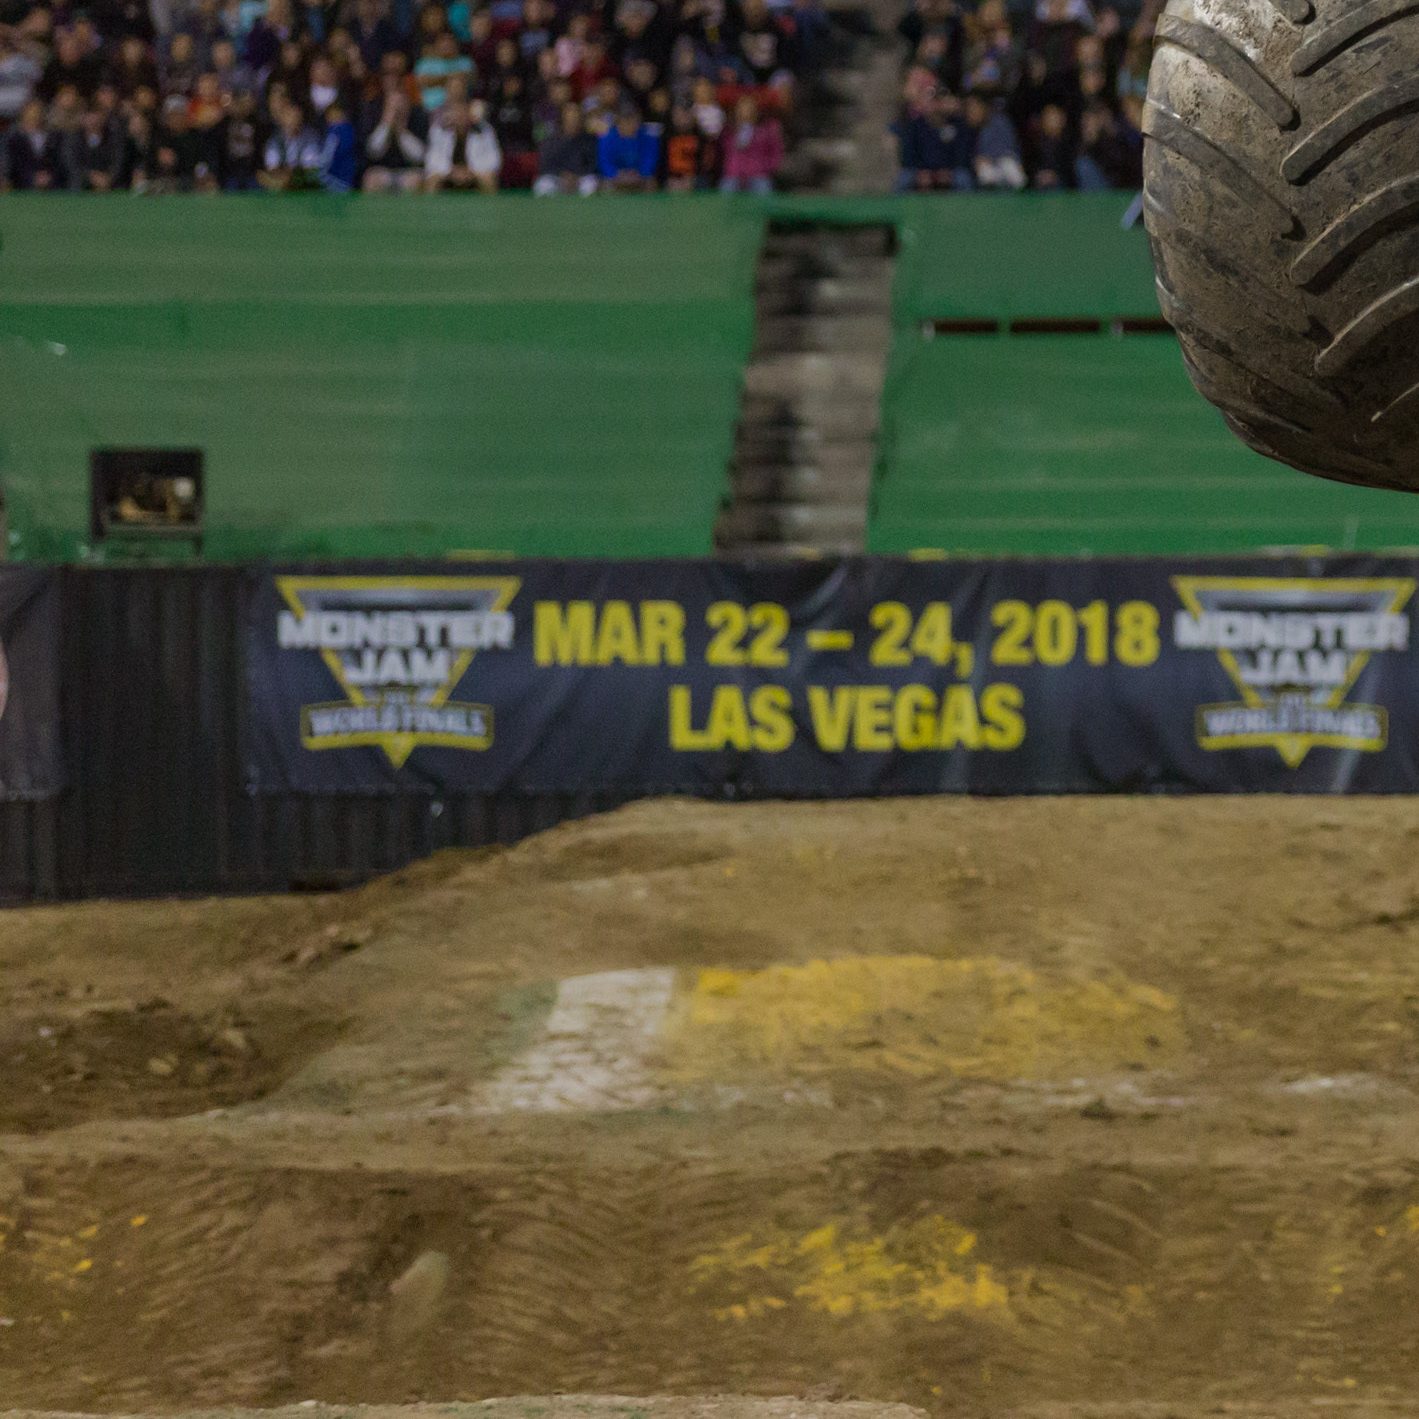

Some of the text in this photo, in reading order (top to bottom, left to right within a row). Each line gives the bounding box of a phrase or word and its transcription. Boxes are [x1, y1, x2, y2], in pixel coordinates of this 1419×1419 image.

[277, 609, 516, 650] MONSTER
[533, 599, 686, 667] MAR
[704, 600, 791, 669] 22
[869, 600, 975, 680] 24,
[990, 600, 1162, 668] 2018
[1173, 608, 1410, 651] MONSTER
[344, 647, 450, 686] JAM
[1239, 647, 1348, 686] JAM
[669, 683, 1026, 753] LAS VEGAS
